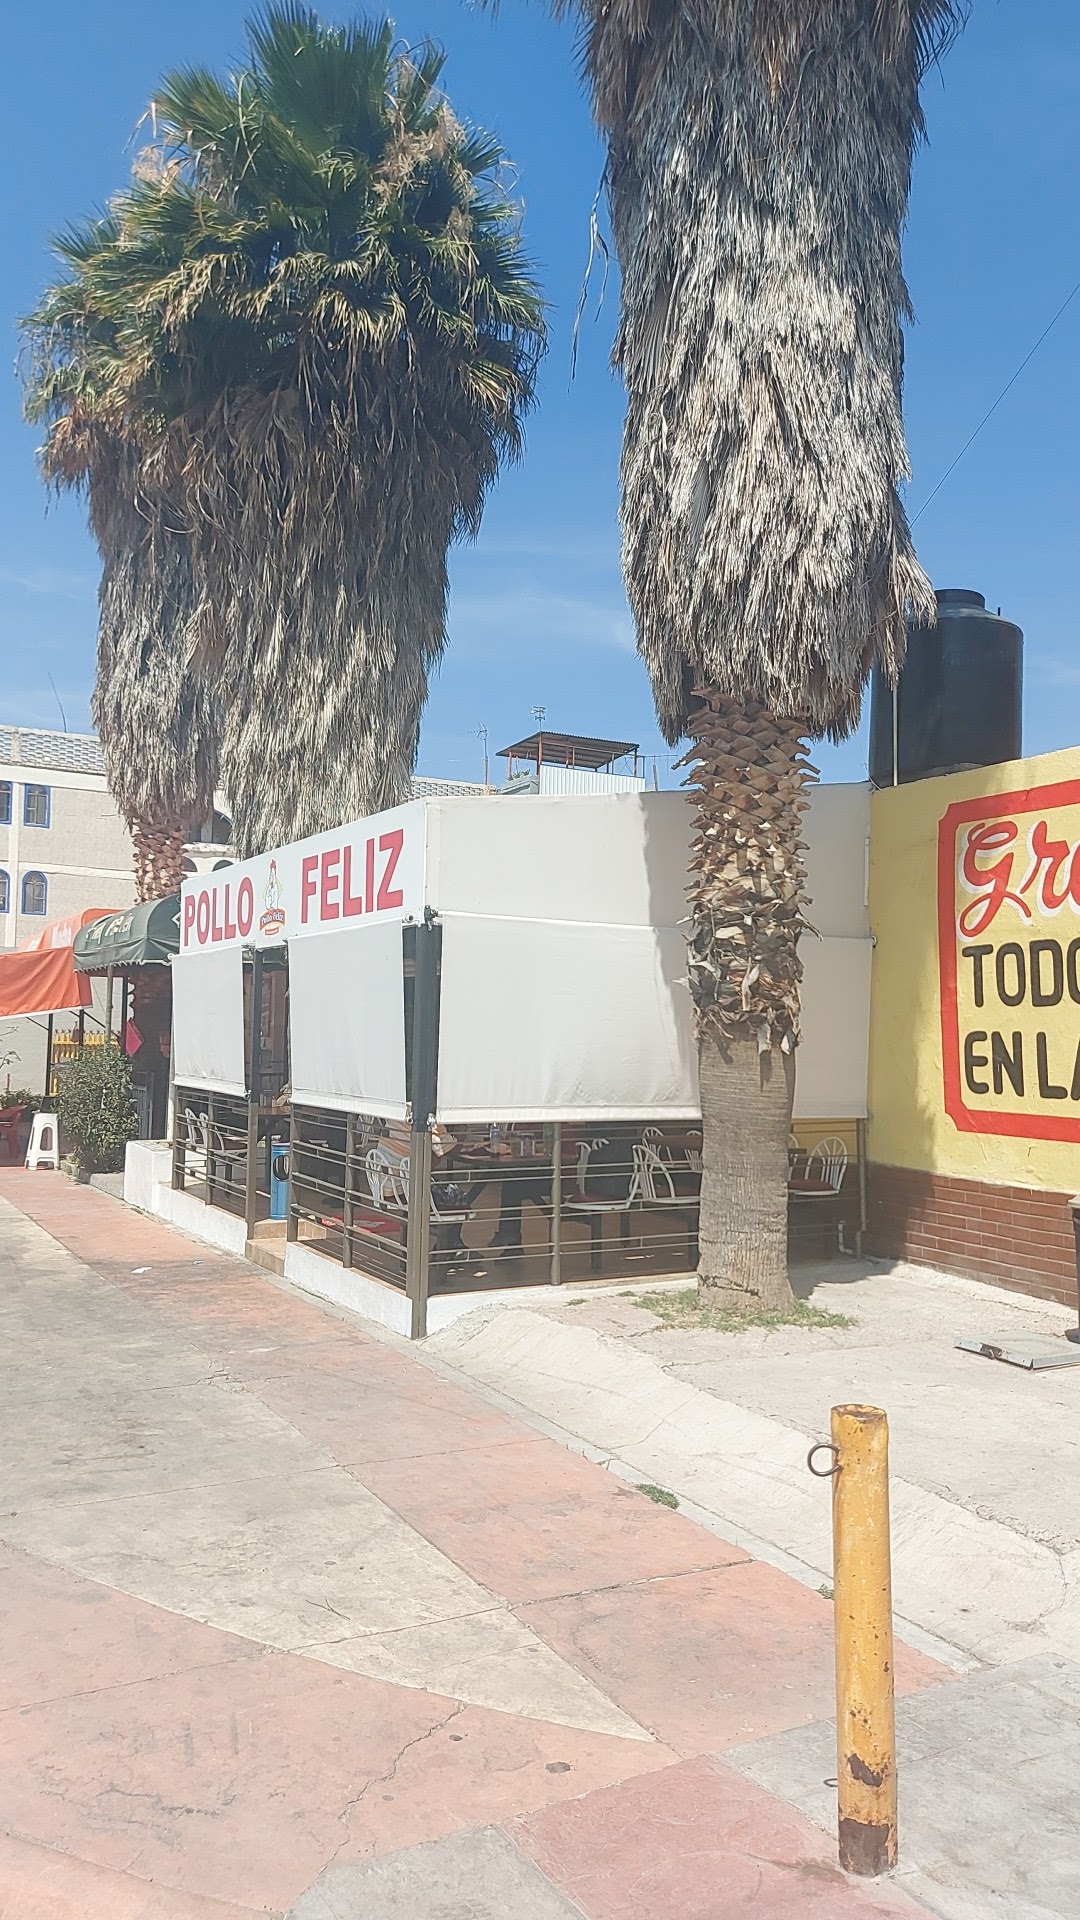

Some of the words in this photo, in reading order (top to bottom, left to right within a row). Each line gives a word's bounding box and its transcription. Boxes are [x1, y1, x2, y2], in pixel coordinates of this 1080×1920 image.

[184, 876, 254, 947] POLLO
[301, 829, 404, 924] FELIZ
[963, 1030, 1025, 1098] EN
[1035, 1030, 1080, 1101] L
